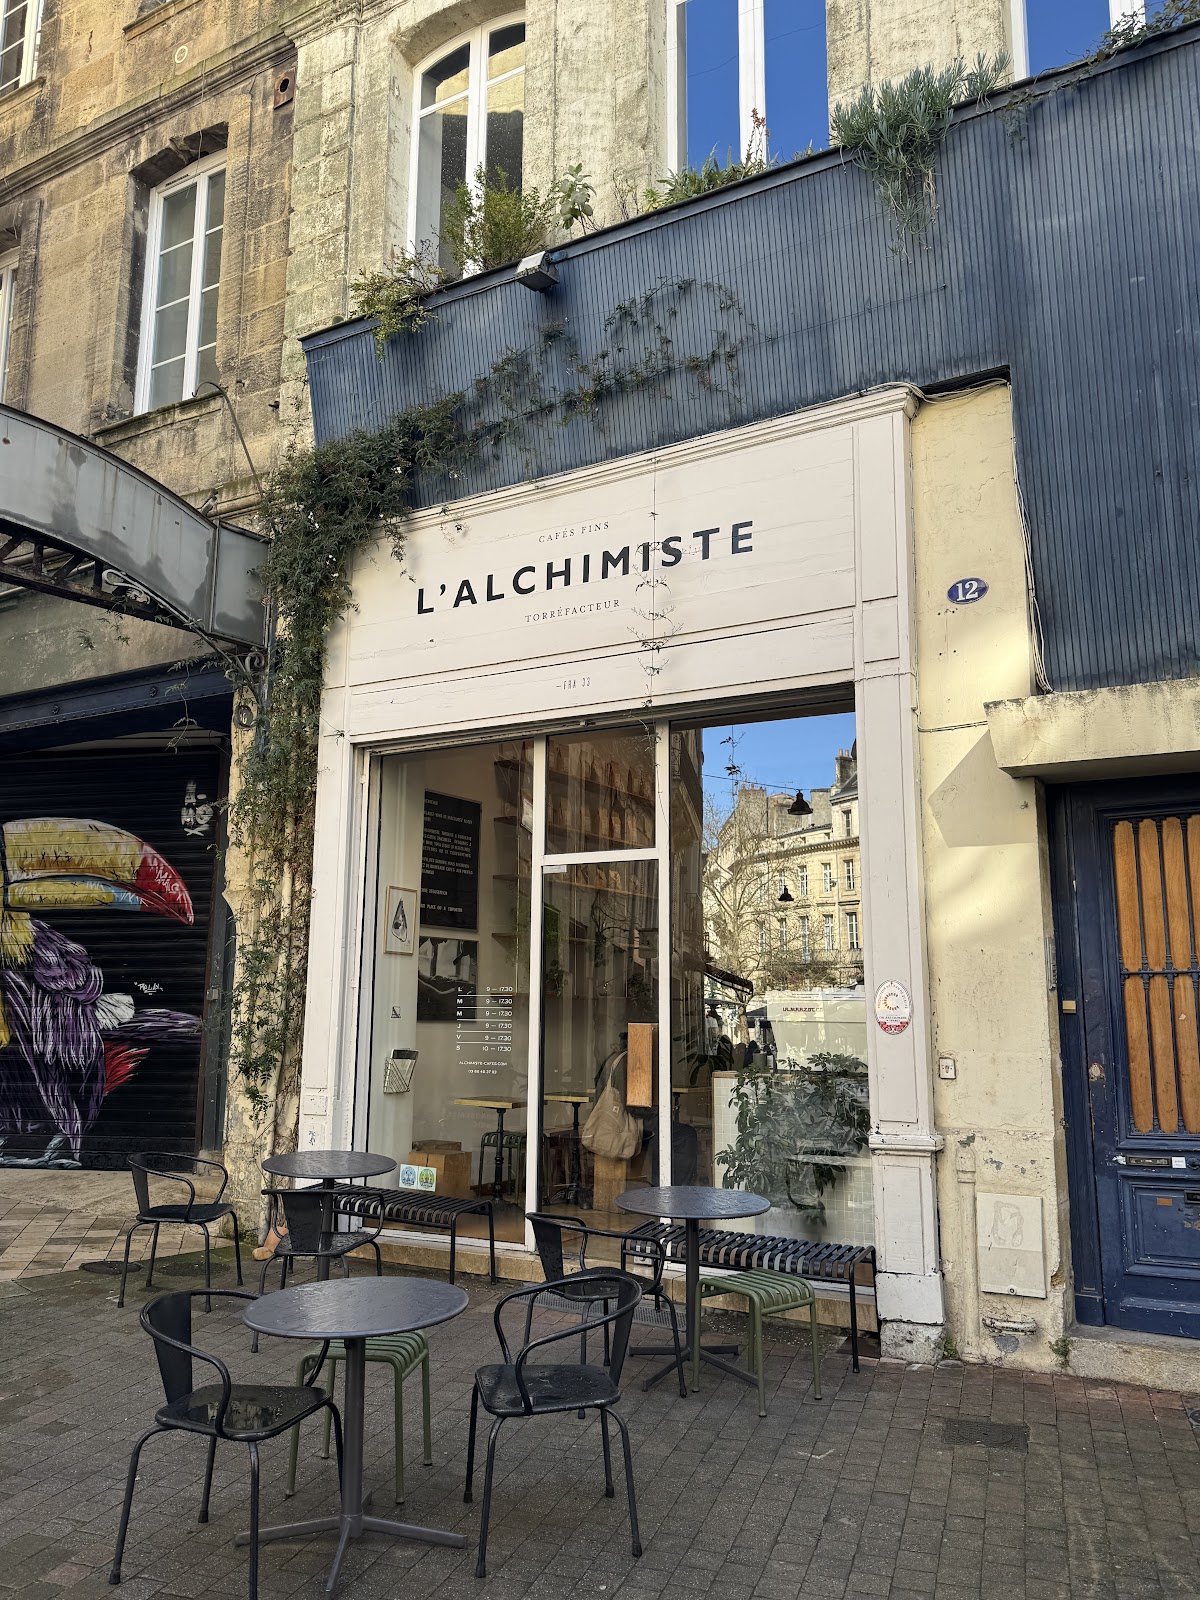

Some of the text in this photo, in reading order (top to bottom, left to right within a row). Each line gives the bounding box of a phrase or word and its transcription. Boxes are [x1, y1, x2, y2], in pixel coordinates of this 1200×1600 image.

[538, 521, 609, 543] CAFÉS FINS
[417, 520, 753, 614] L’ALCHIMISTE
[955, 580, 979, 601] 12
[524, 599, 620, 622] TORRÉFACTEUR
